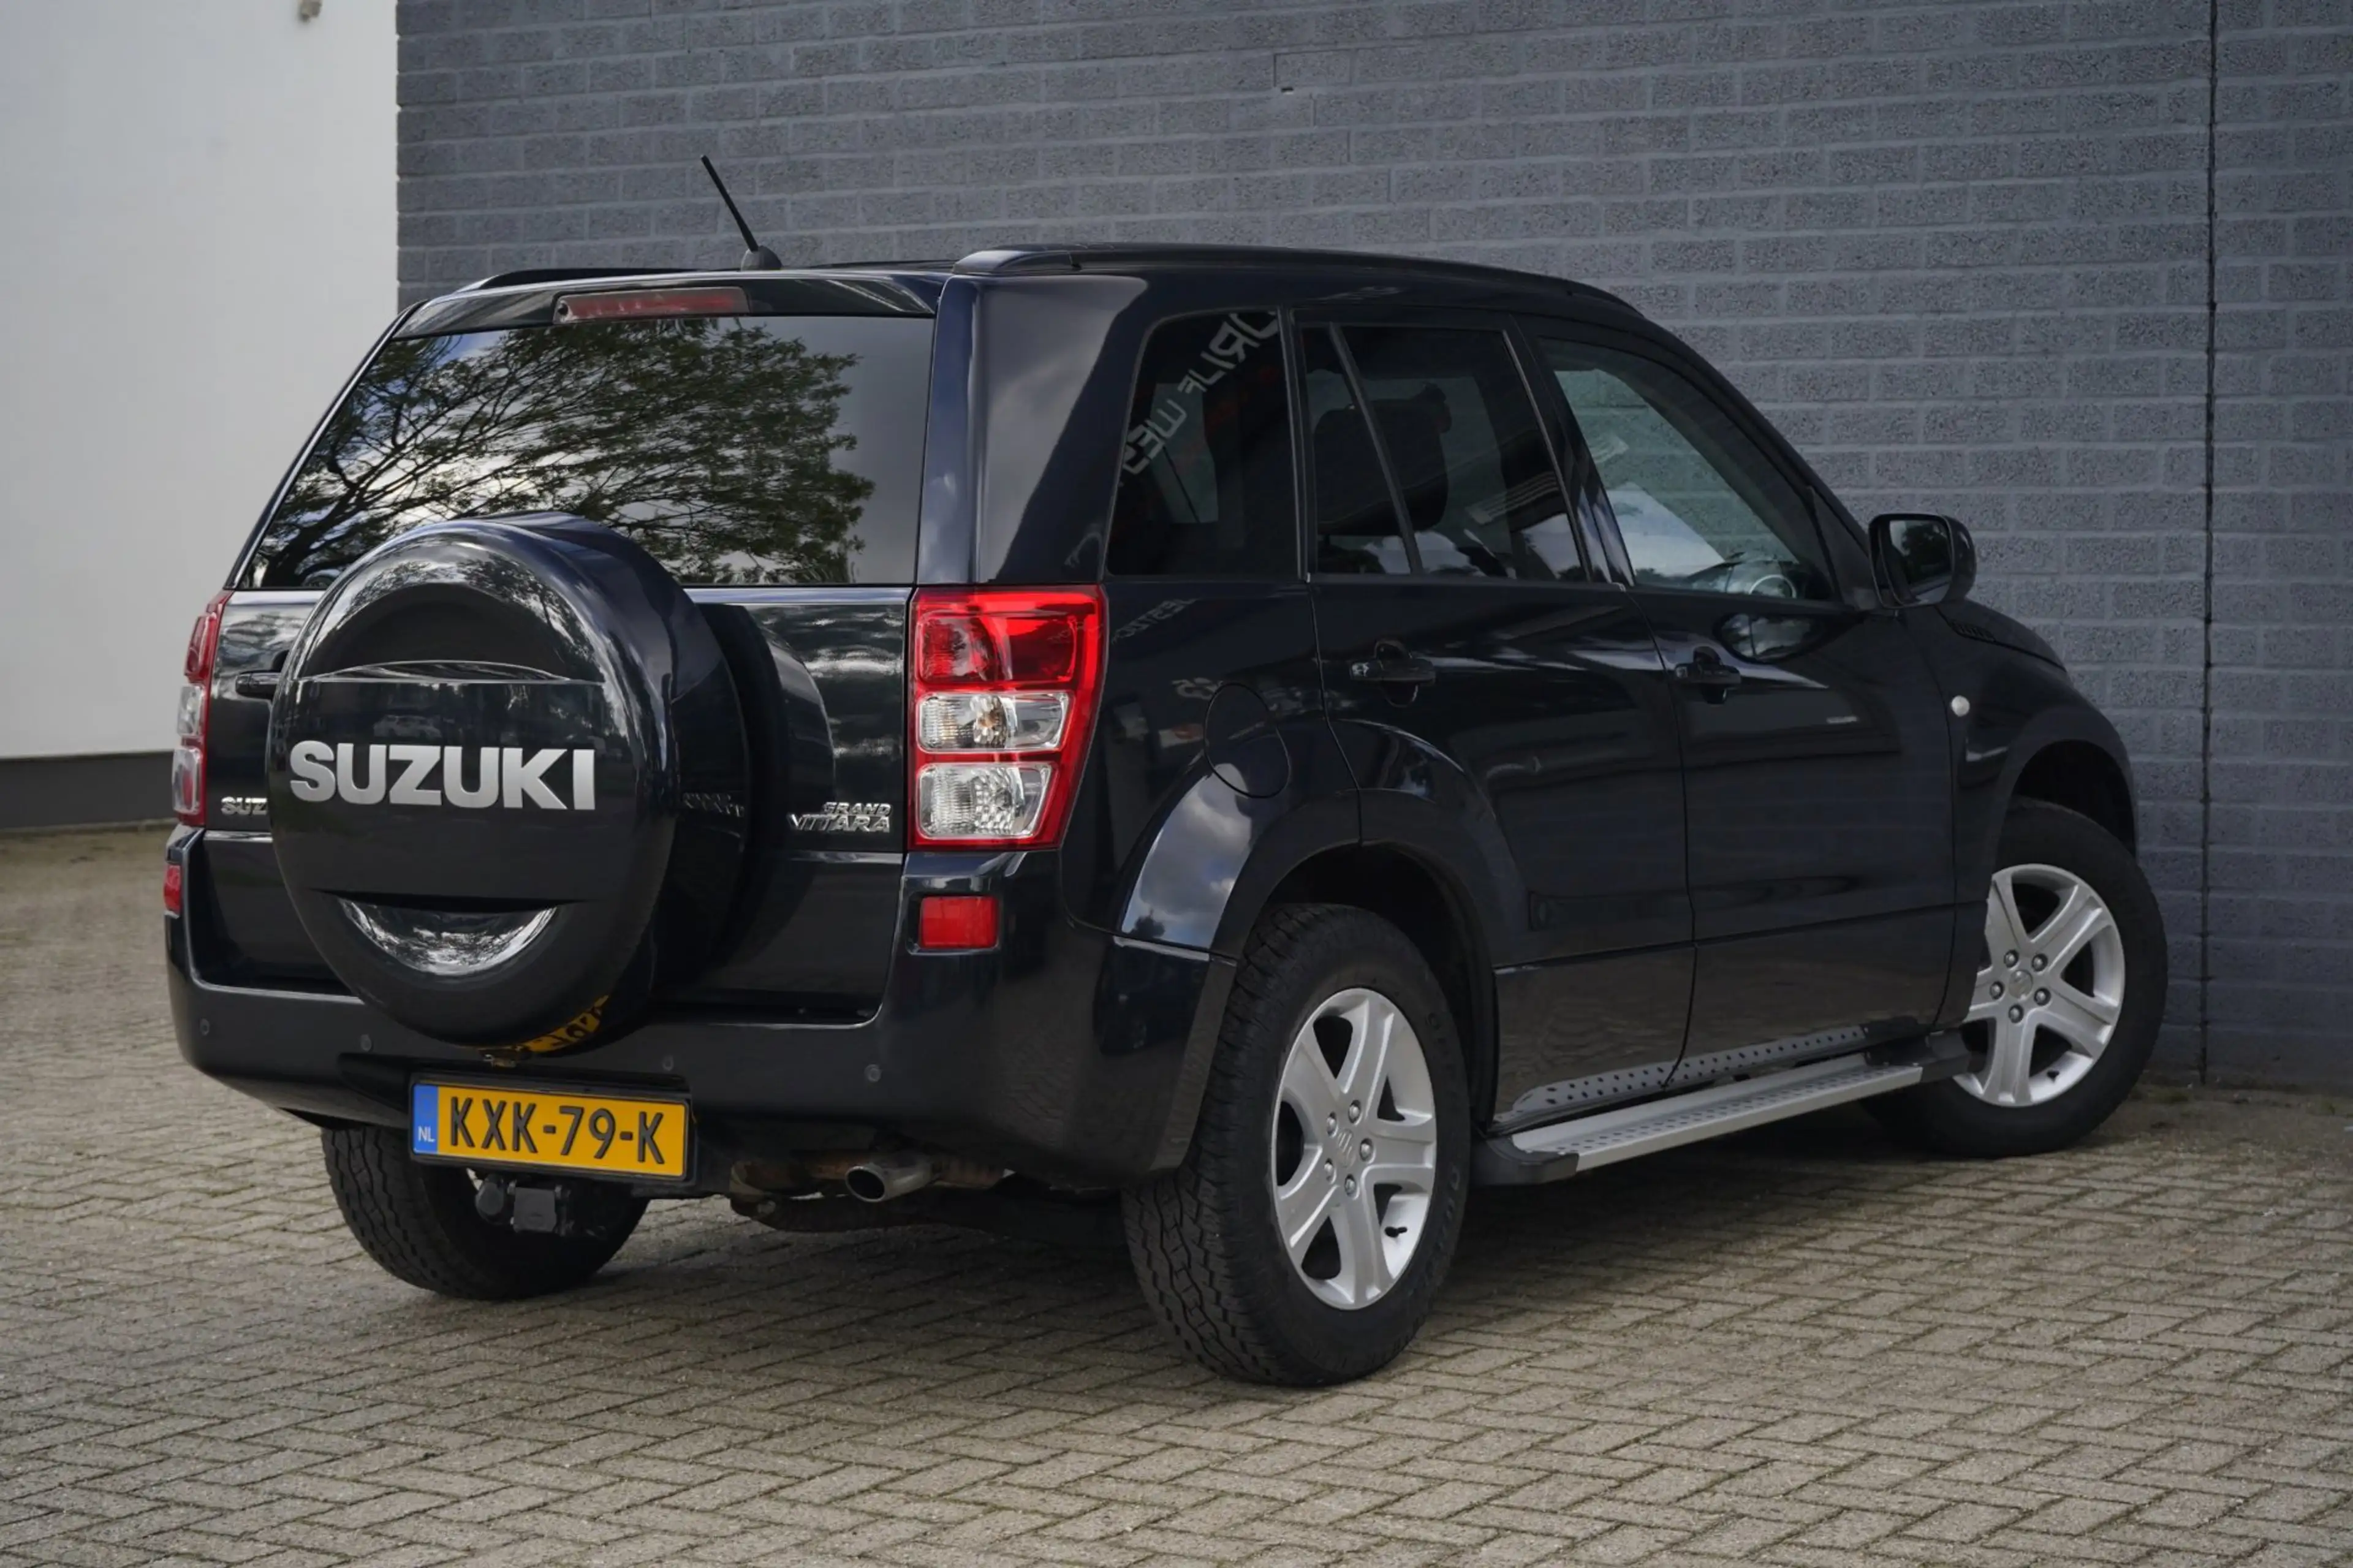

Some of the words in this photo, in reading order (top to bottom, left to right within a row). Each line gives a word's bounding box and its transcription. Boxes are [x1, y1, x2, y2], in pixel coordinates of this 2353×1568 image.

[289, 740, 596, 810] SUZUKI
[823, 801, 892, 816] GRAND
[787, 812, 890, 833] VITARA
[418, 1126, 435, 1142] NL
[450, 1096, 665, 1164] KXK-79-K
